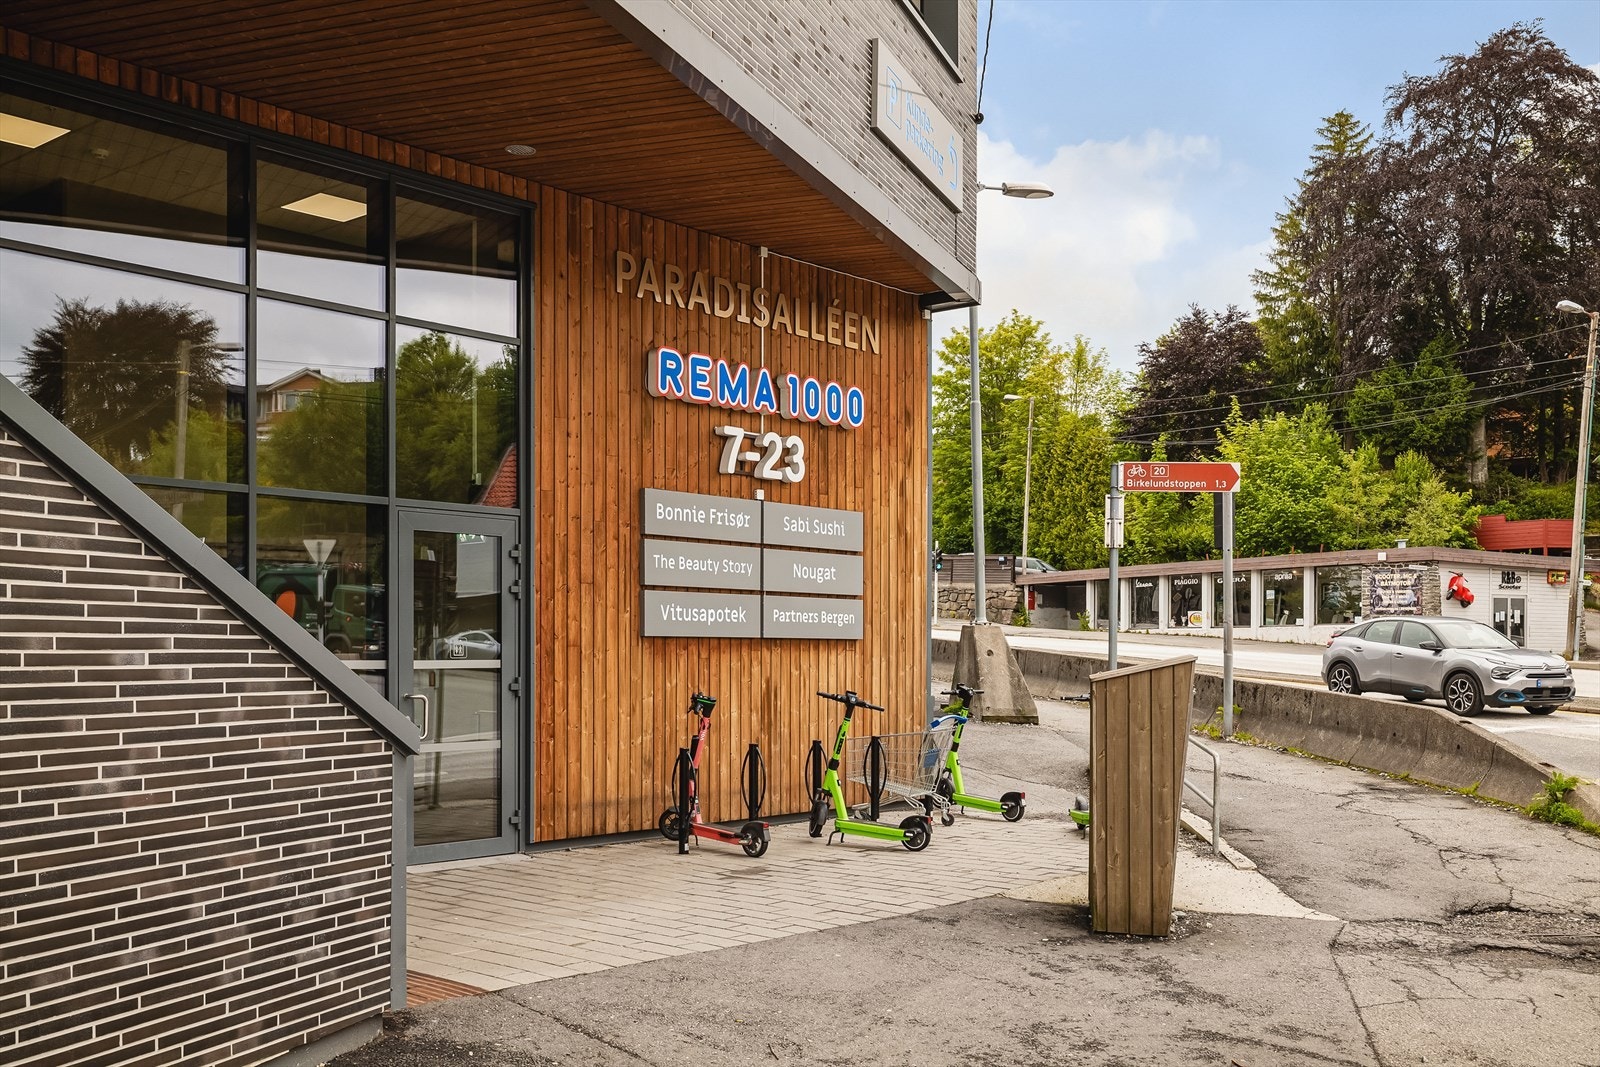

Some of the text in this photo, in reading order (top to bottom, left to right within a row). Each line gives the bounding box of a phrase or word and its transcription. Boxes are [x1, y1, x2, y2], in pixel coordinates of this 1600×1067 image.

[905, 118, 943, 177] parkering
[616, 250, 880, 354] PARADISALLÉEN
[656, 345, 865, 428] REMA 1000
[715, 425, 806, 483] 7-23
[1153, 466, 1166, 476] 20
[1126, 479, 1207, 489] Birkelundstoppen
[656, 503, 751, 529] Bonnie Frisør
[783, 516, 846, 537] Sabi Sushi
[653, 554, 753, 577] The Beauty Story
[793, 563, 837, 584] Nougat
[1135, 579, 1153, 588] Vespa
[1174, 578, 1199, 586] PIAGGIO
[1274, 573, 1293, 582] aprilia
[660, 604, 747, 626] Vitusapotek
[773, 609, 855, 627] Partners Bergen
